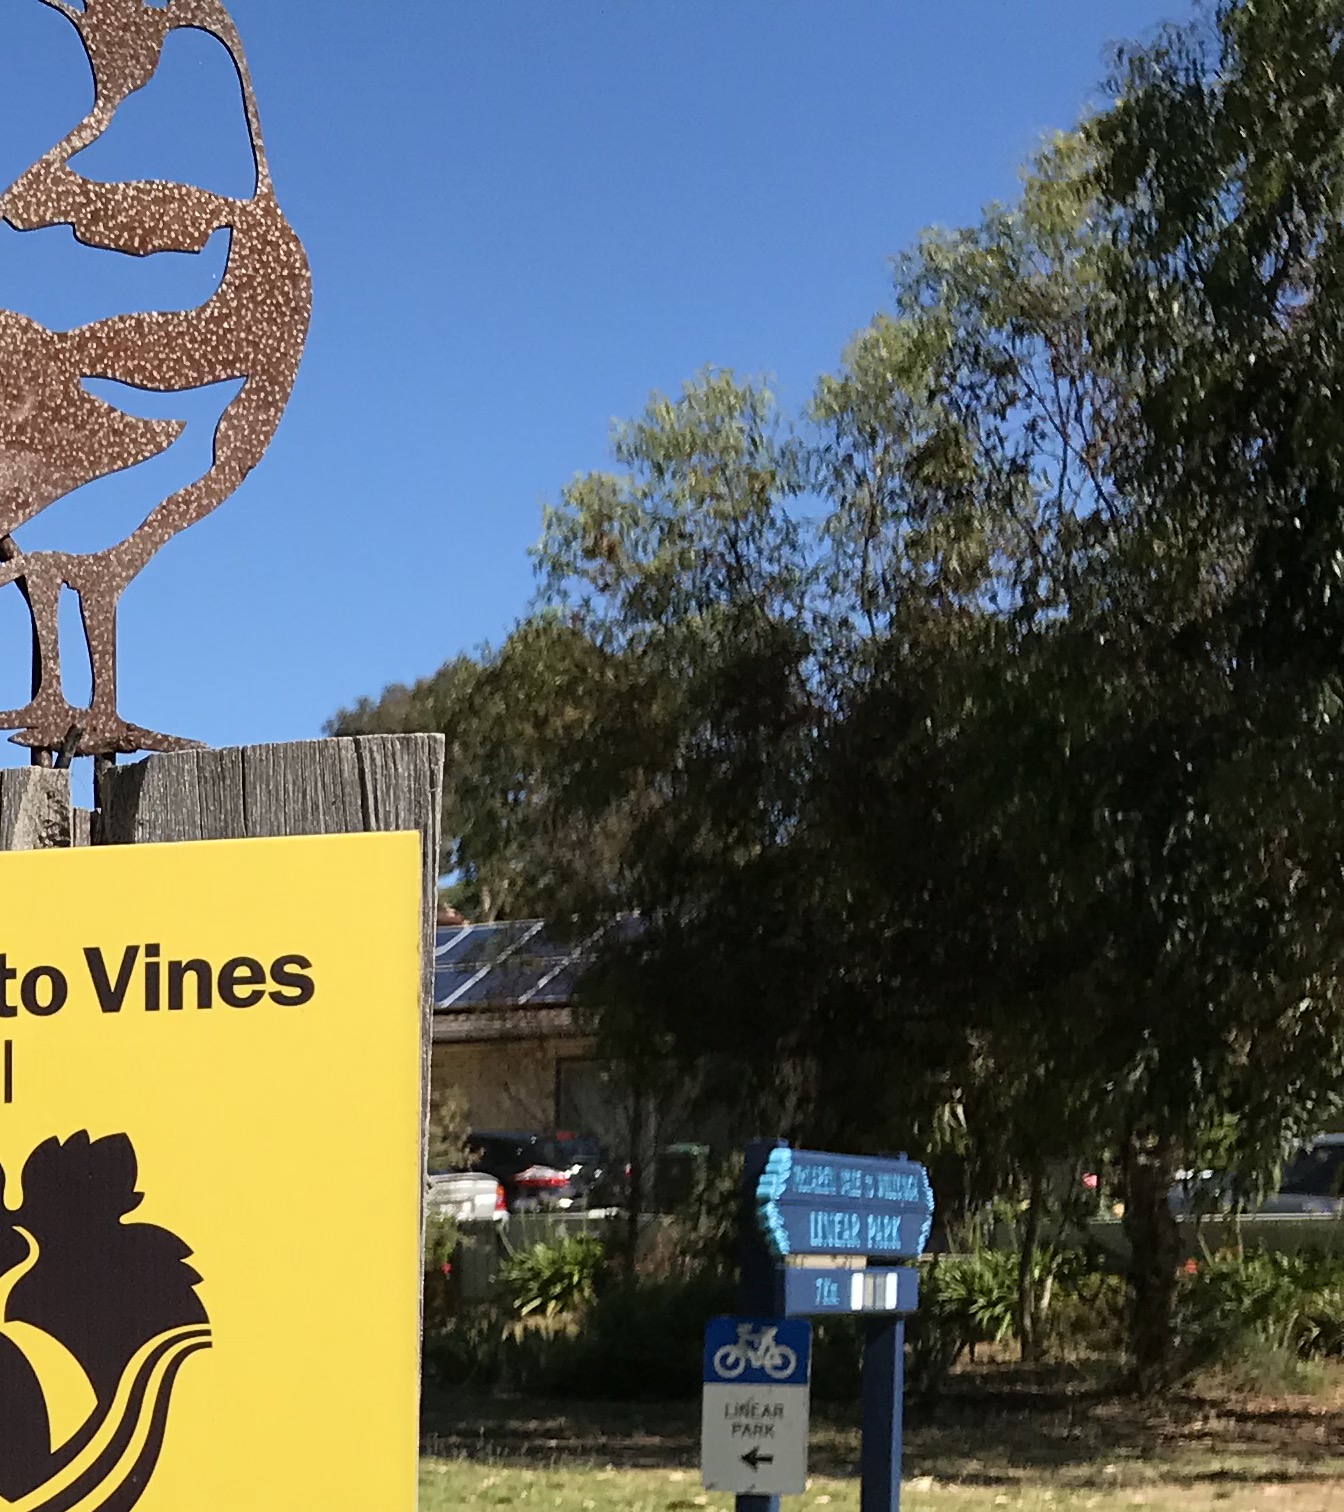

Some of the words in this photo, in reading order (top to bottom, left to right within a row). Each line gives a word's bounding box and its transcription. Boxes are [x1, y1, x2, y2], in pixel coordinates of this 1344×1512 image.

[82, 942, 315, 1014] Vines
[810, 1211, 861, 1249] LINEAR
[867, 1213, 902, 1250] PARK
